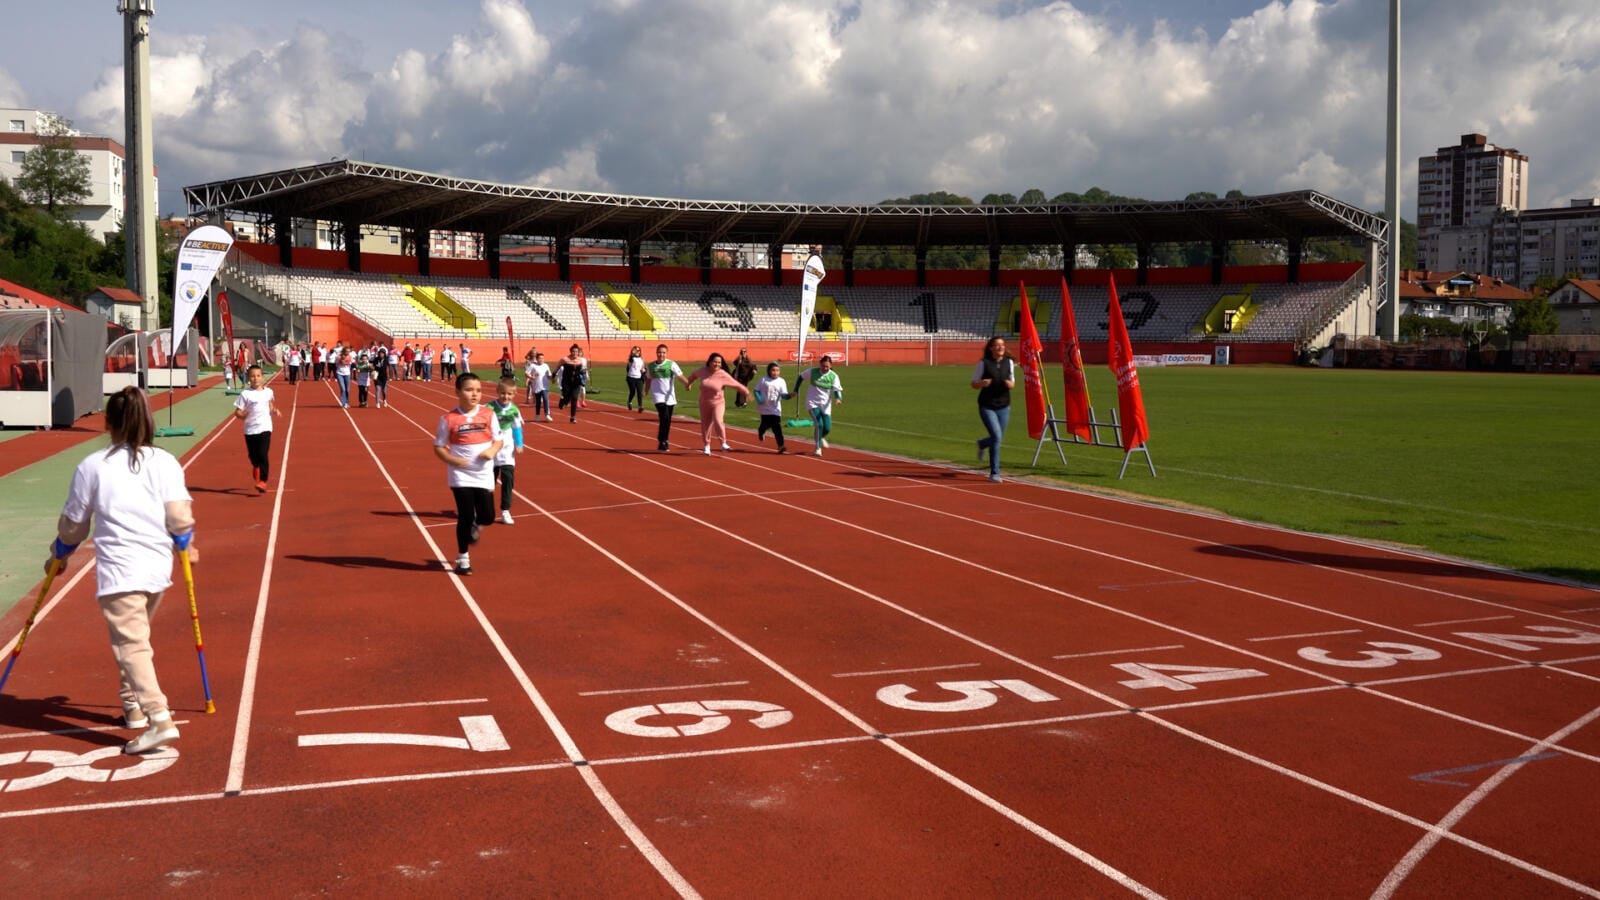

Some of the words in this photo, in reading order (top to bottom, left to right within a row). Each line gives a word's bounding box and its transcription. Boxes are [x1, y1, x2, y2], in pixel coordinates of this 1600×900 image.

[186, 240, 228, 252] #BEACTIVE
[696, 290, 756, 332] 9
[908, 292, 938, 333] 1
[1097, 291, 1160, 330] 9
[1167, 354, 1205, 363] topdom
[1451, 625, 1600, 652] 2
[1297, 640, 1442, 670] 3
[1110, 661, 1269, 692] 4
[875, 679, 1060, 713] 5
[298, 714, 511, 753] 7
[604, 698, 794, 739] 6
[0, 745, 180, 793] 8
